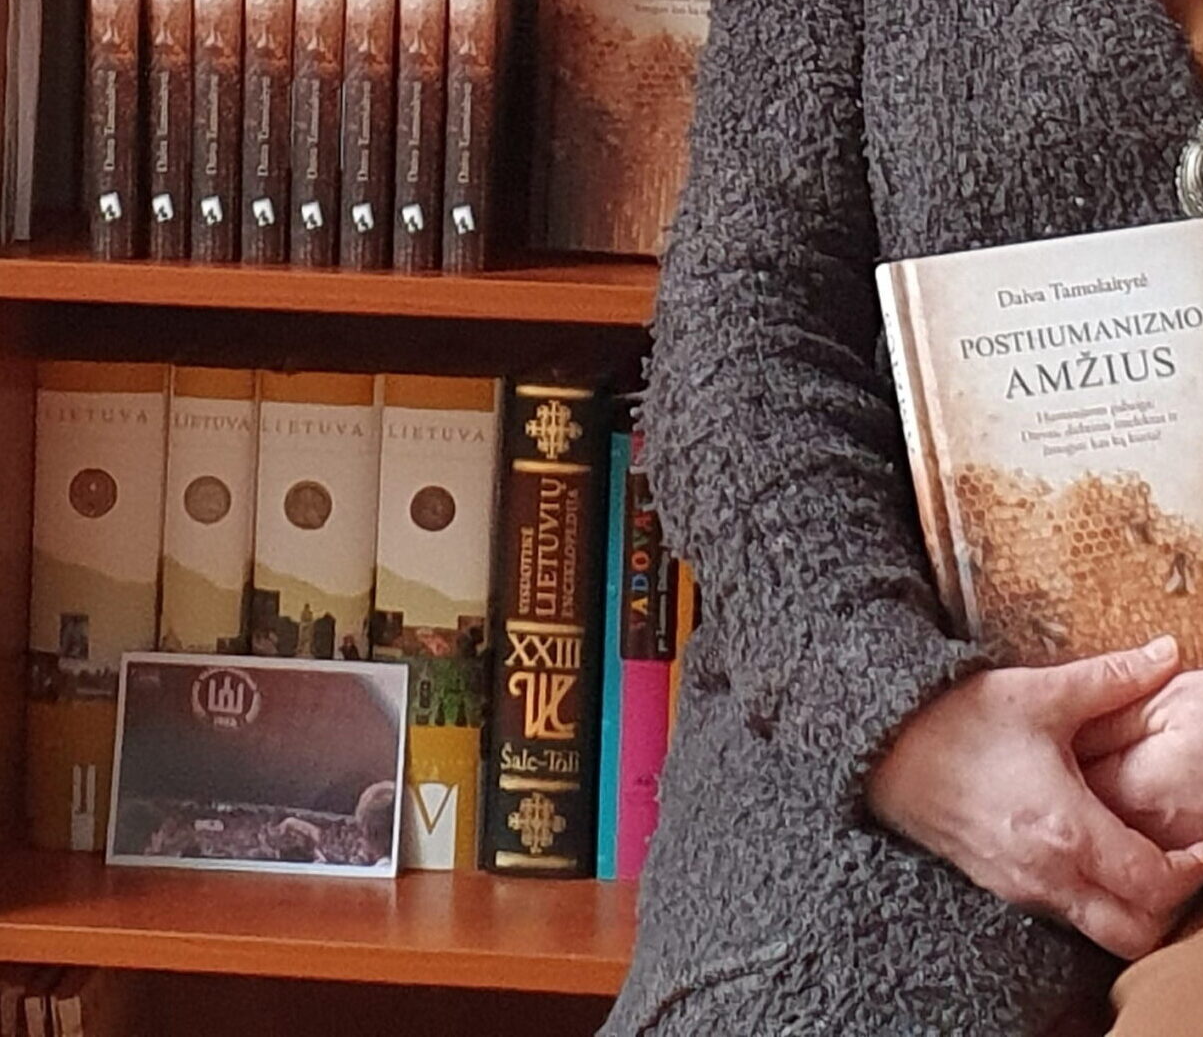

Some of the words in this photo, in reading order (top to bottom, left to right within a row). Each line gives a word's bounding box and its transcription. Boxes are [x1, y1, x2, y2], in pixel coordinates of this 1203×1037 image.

[997, 289, 1046, 308] Daiva
[959, 305, 1203, 360] POSTHUMANIZMO
[1005, 345, 1176, 399] AMŽIUS
[387, 423, 485, 443] LIETUVA
[535, 478, 567, 616] LIETUVIŲ
[504, 631, 581, 669] XXIII
